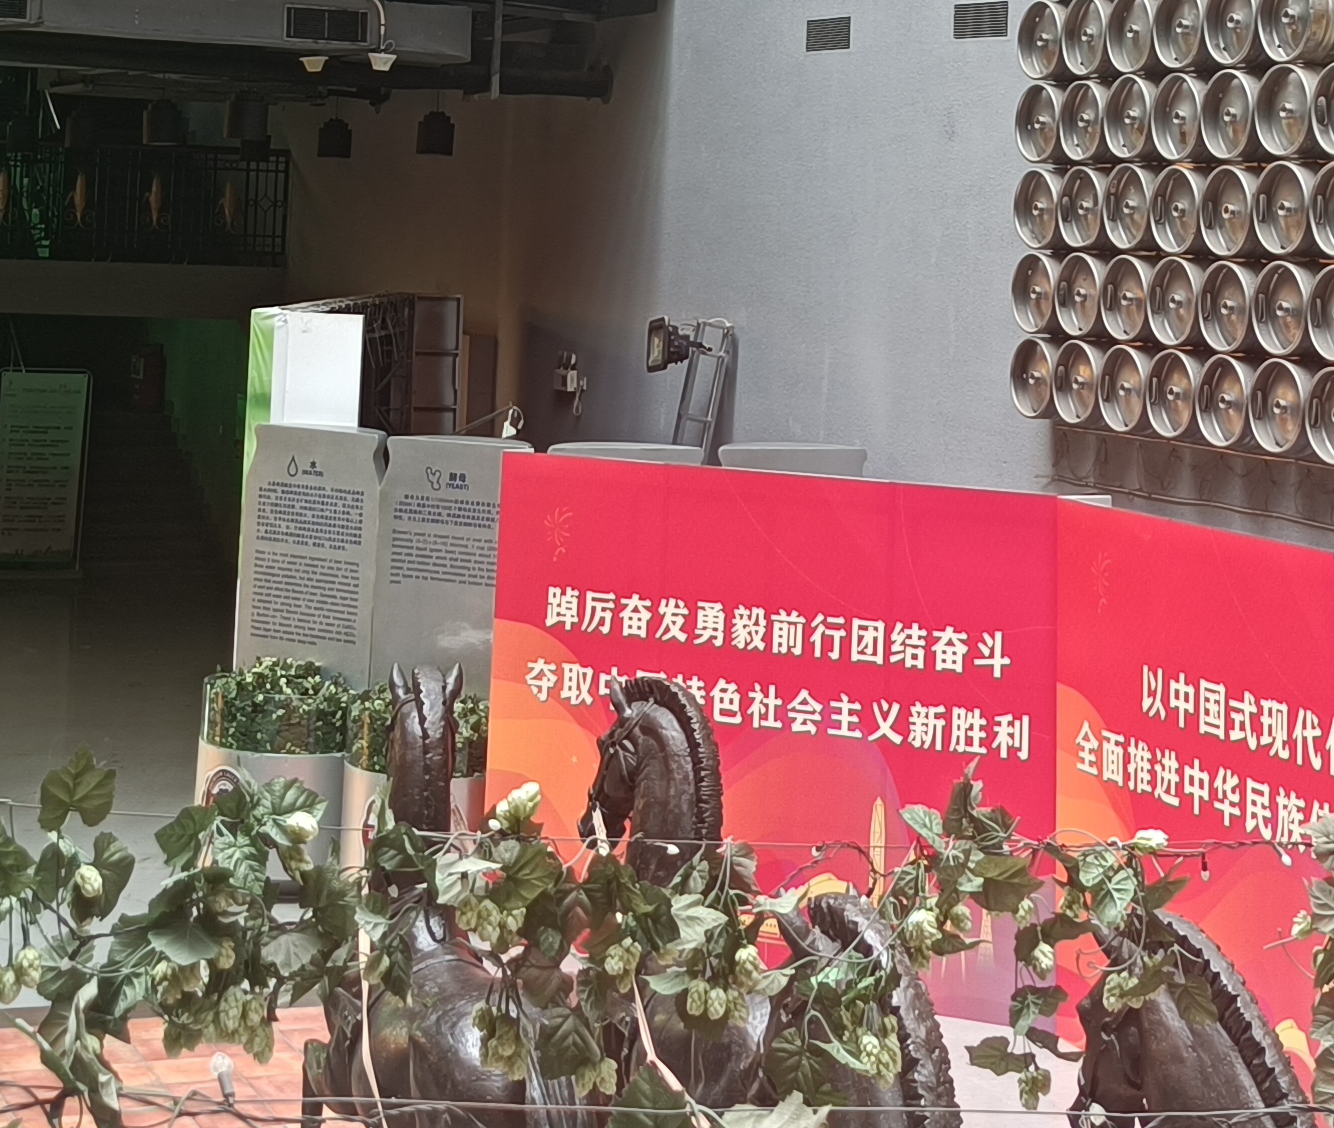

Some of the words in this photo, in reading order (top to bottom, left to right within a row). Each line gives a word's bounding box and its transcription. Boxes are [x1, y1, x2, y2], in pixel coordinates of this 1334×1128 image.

[544, 585, 1012, 679] 踔厉奋发勇毅前行团结奋斗
